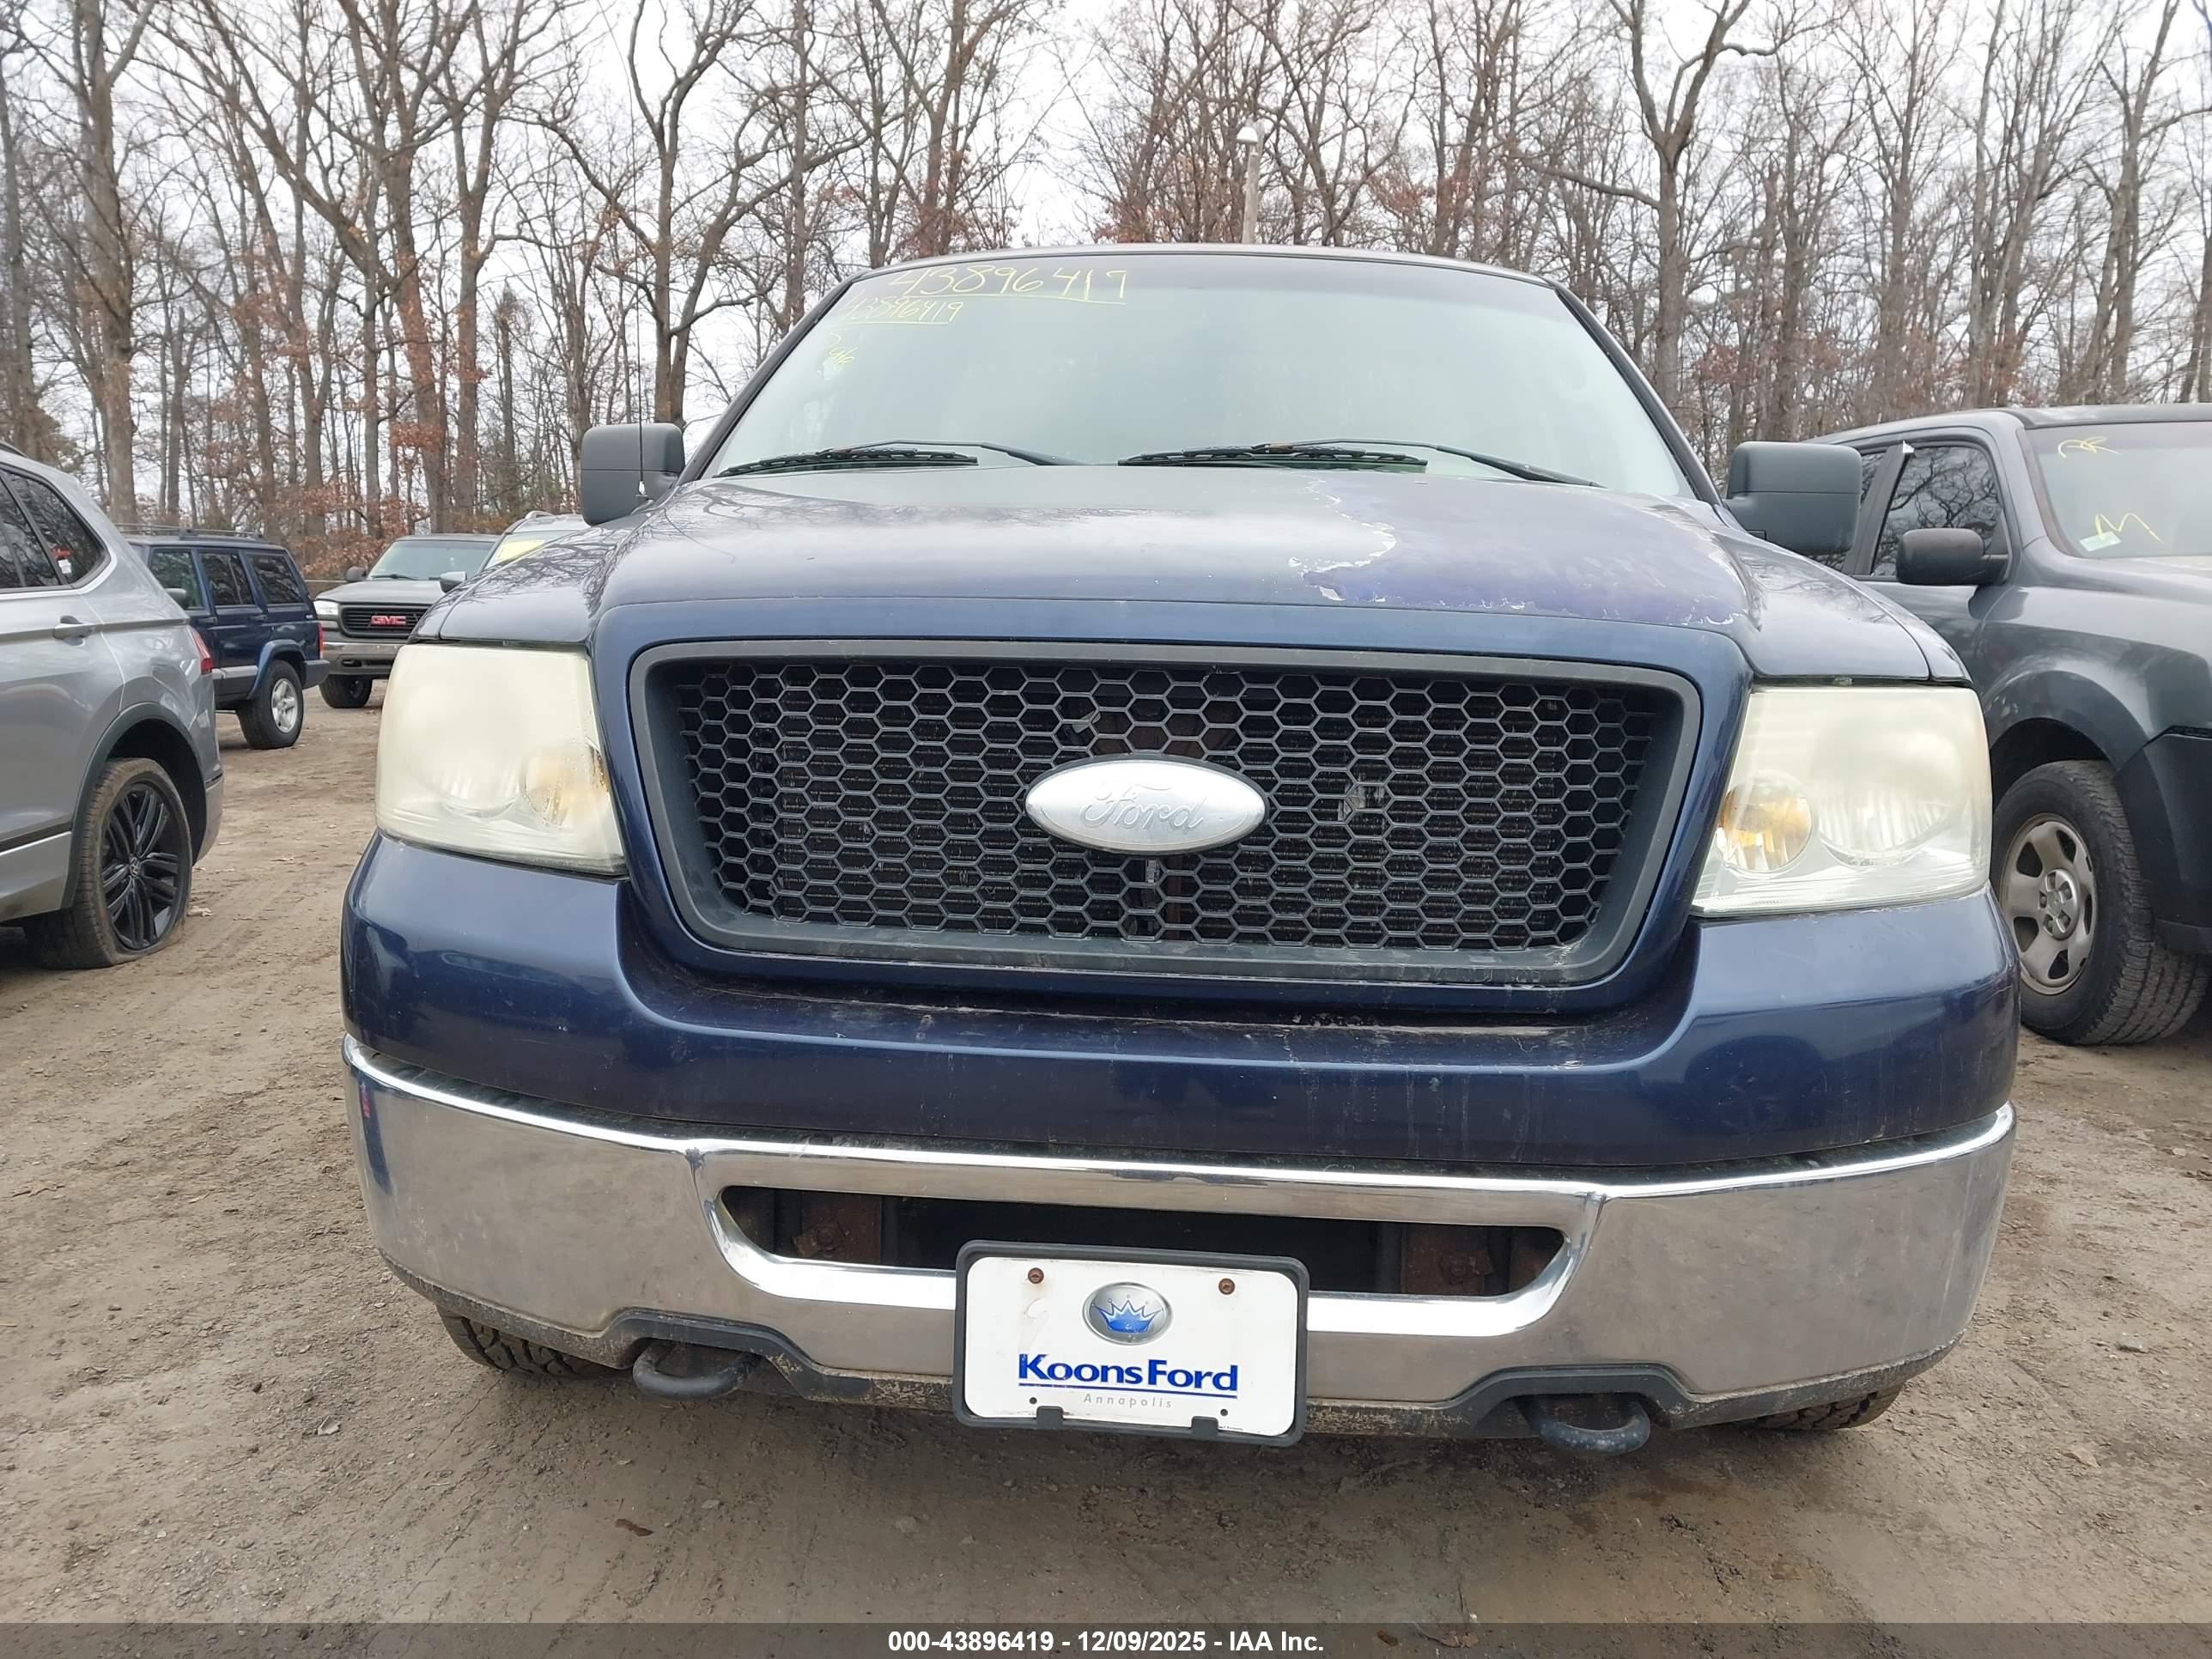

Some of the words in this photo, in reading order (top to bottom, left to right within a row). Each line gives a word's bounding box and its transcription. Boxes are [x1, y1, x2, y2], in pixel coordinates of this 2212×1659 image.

[371, 615, 406, 625] GMC
[1079, 782, 1208, 830] Ford
[1084, 1393, 1173, 1409] Annapolis
